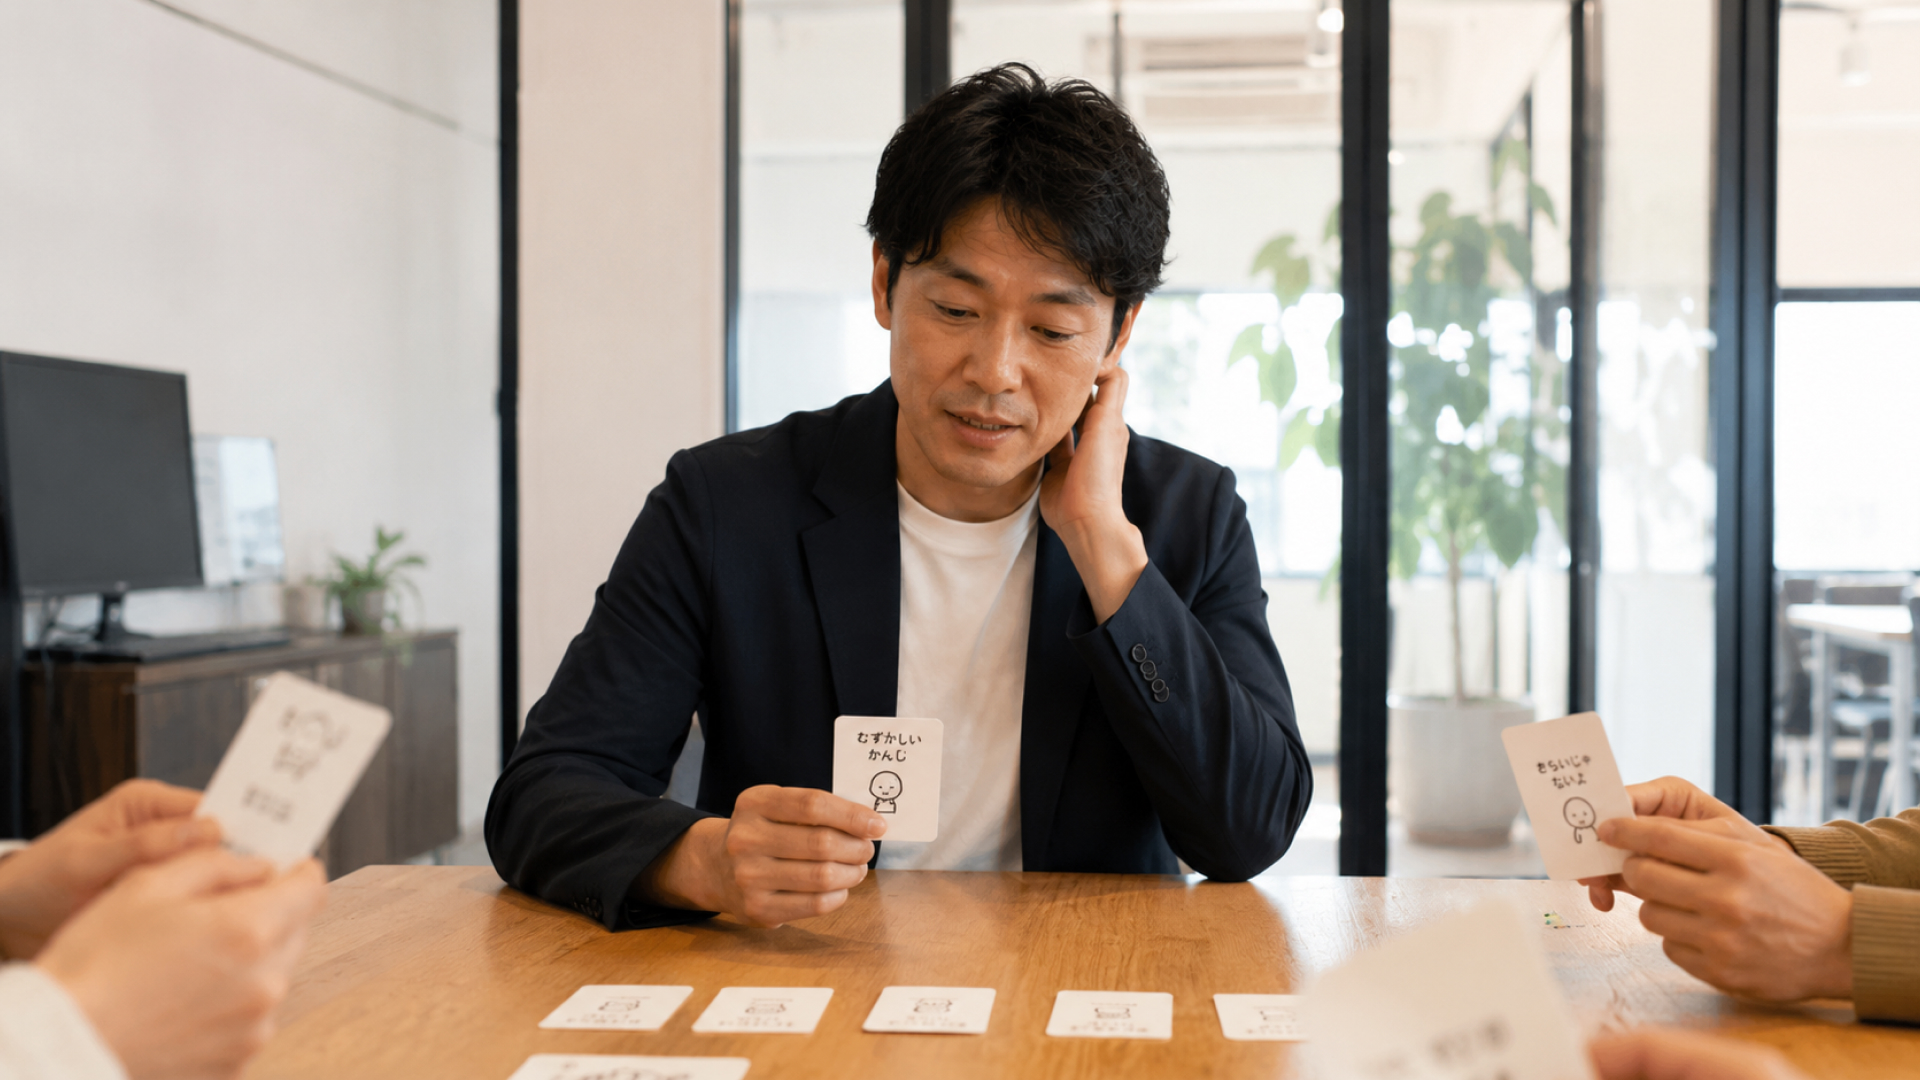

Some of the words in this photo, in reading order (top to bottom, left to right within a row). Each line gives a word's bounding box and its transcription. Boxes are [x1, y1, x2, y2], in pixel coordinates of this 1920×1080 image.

[857, 731, 922, 746] むずかしい
[868, 748, 907, 762] かんじ
[1552, 773, 1587, 789] ないよ
